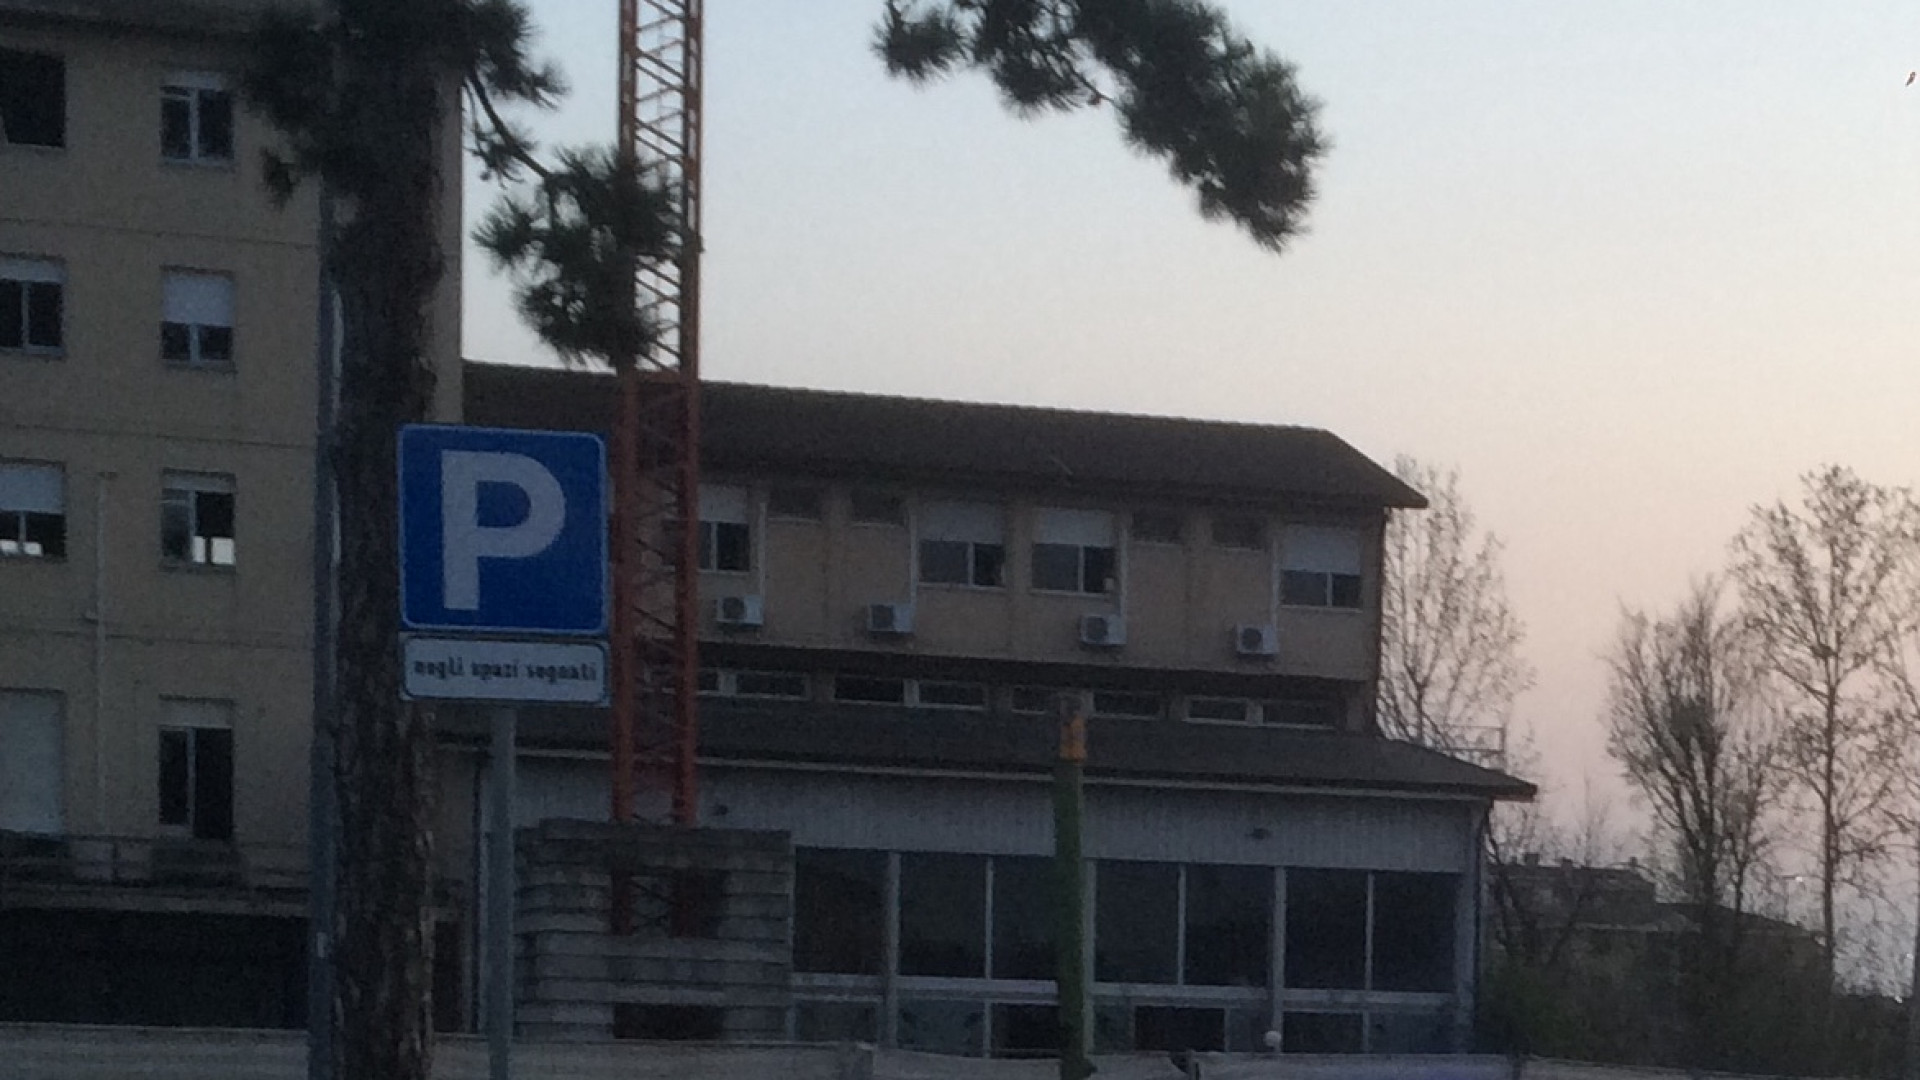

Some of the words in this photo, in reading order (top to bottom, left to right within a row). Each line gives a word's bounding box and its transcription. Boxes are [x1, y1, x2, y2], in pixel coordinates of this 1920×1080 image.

[441, 449, 567, 611] P
[414, 657, 464, 679] negli
[471, 659, 519, 680] spazi
[526, 661, 597, 684] segnati
